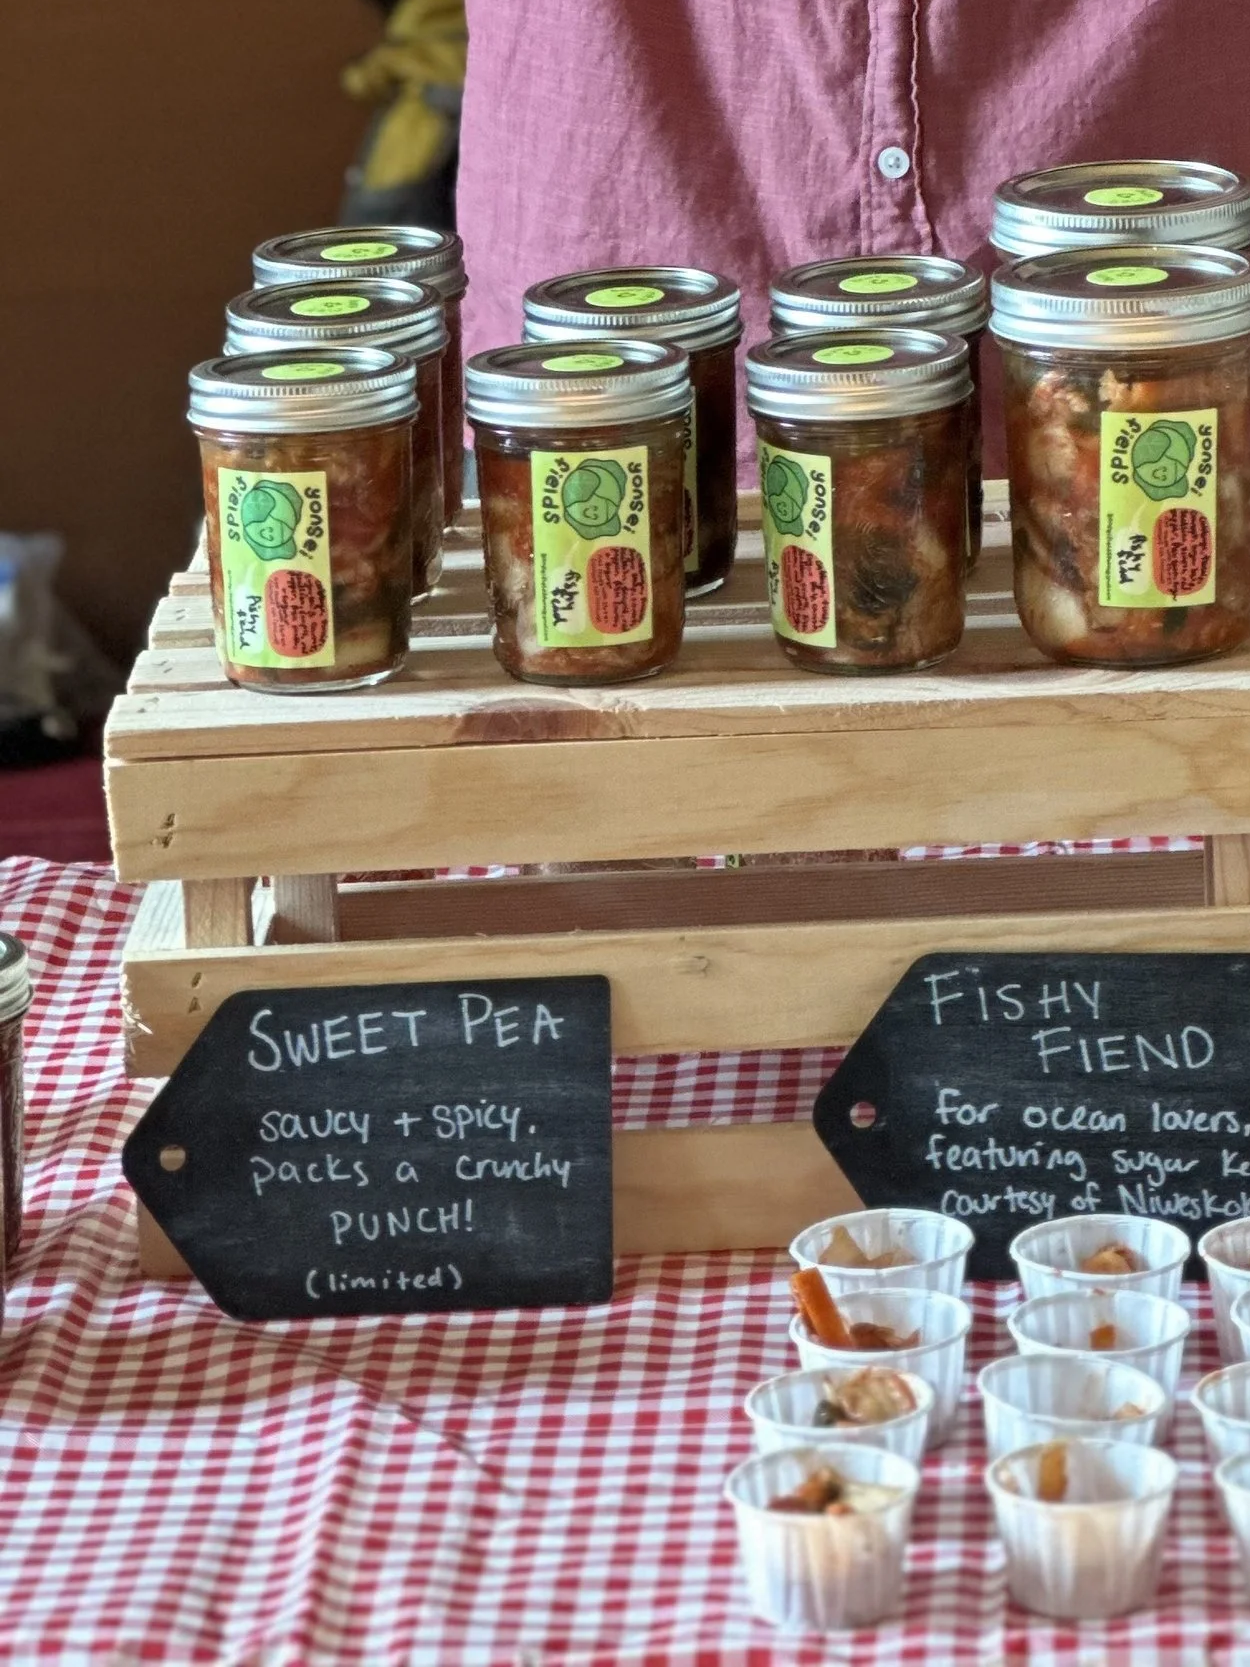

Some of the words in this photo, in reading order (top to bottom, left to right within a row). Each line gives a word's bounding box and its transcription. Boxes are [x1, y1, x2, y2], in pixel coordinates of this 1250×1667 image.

[248, 1009, 427, 1072] SWEET
[458, 993, 565, 1048] PEA
[1031, 1025, 1214, 1073] FIEND
[259, 1108, 370, 1144] saucy
[394, 1108, 423, 1136] +
[934, 1087, 999, 1127] for
[1023, 1104, 1127, 1134] ocean
[249, 1155, 370, 1196] packs
[395, 1161, 419, 1183] a
[455, 1153, 572, 1189] crunchy
[925, 1133, 1088, 1182] featuring
[1112, 1148, 1199, 1186] sugar
[329, 1198, 475, 1245] PUNCH!
[1071, 1182, 1101, 1215] of
[305, 1263, 464, 1299] (limited)
